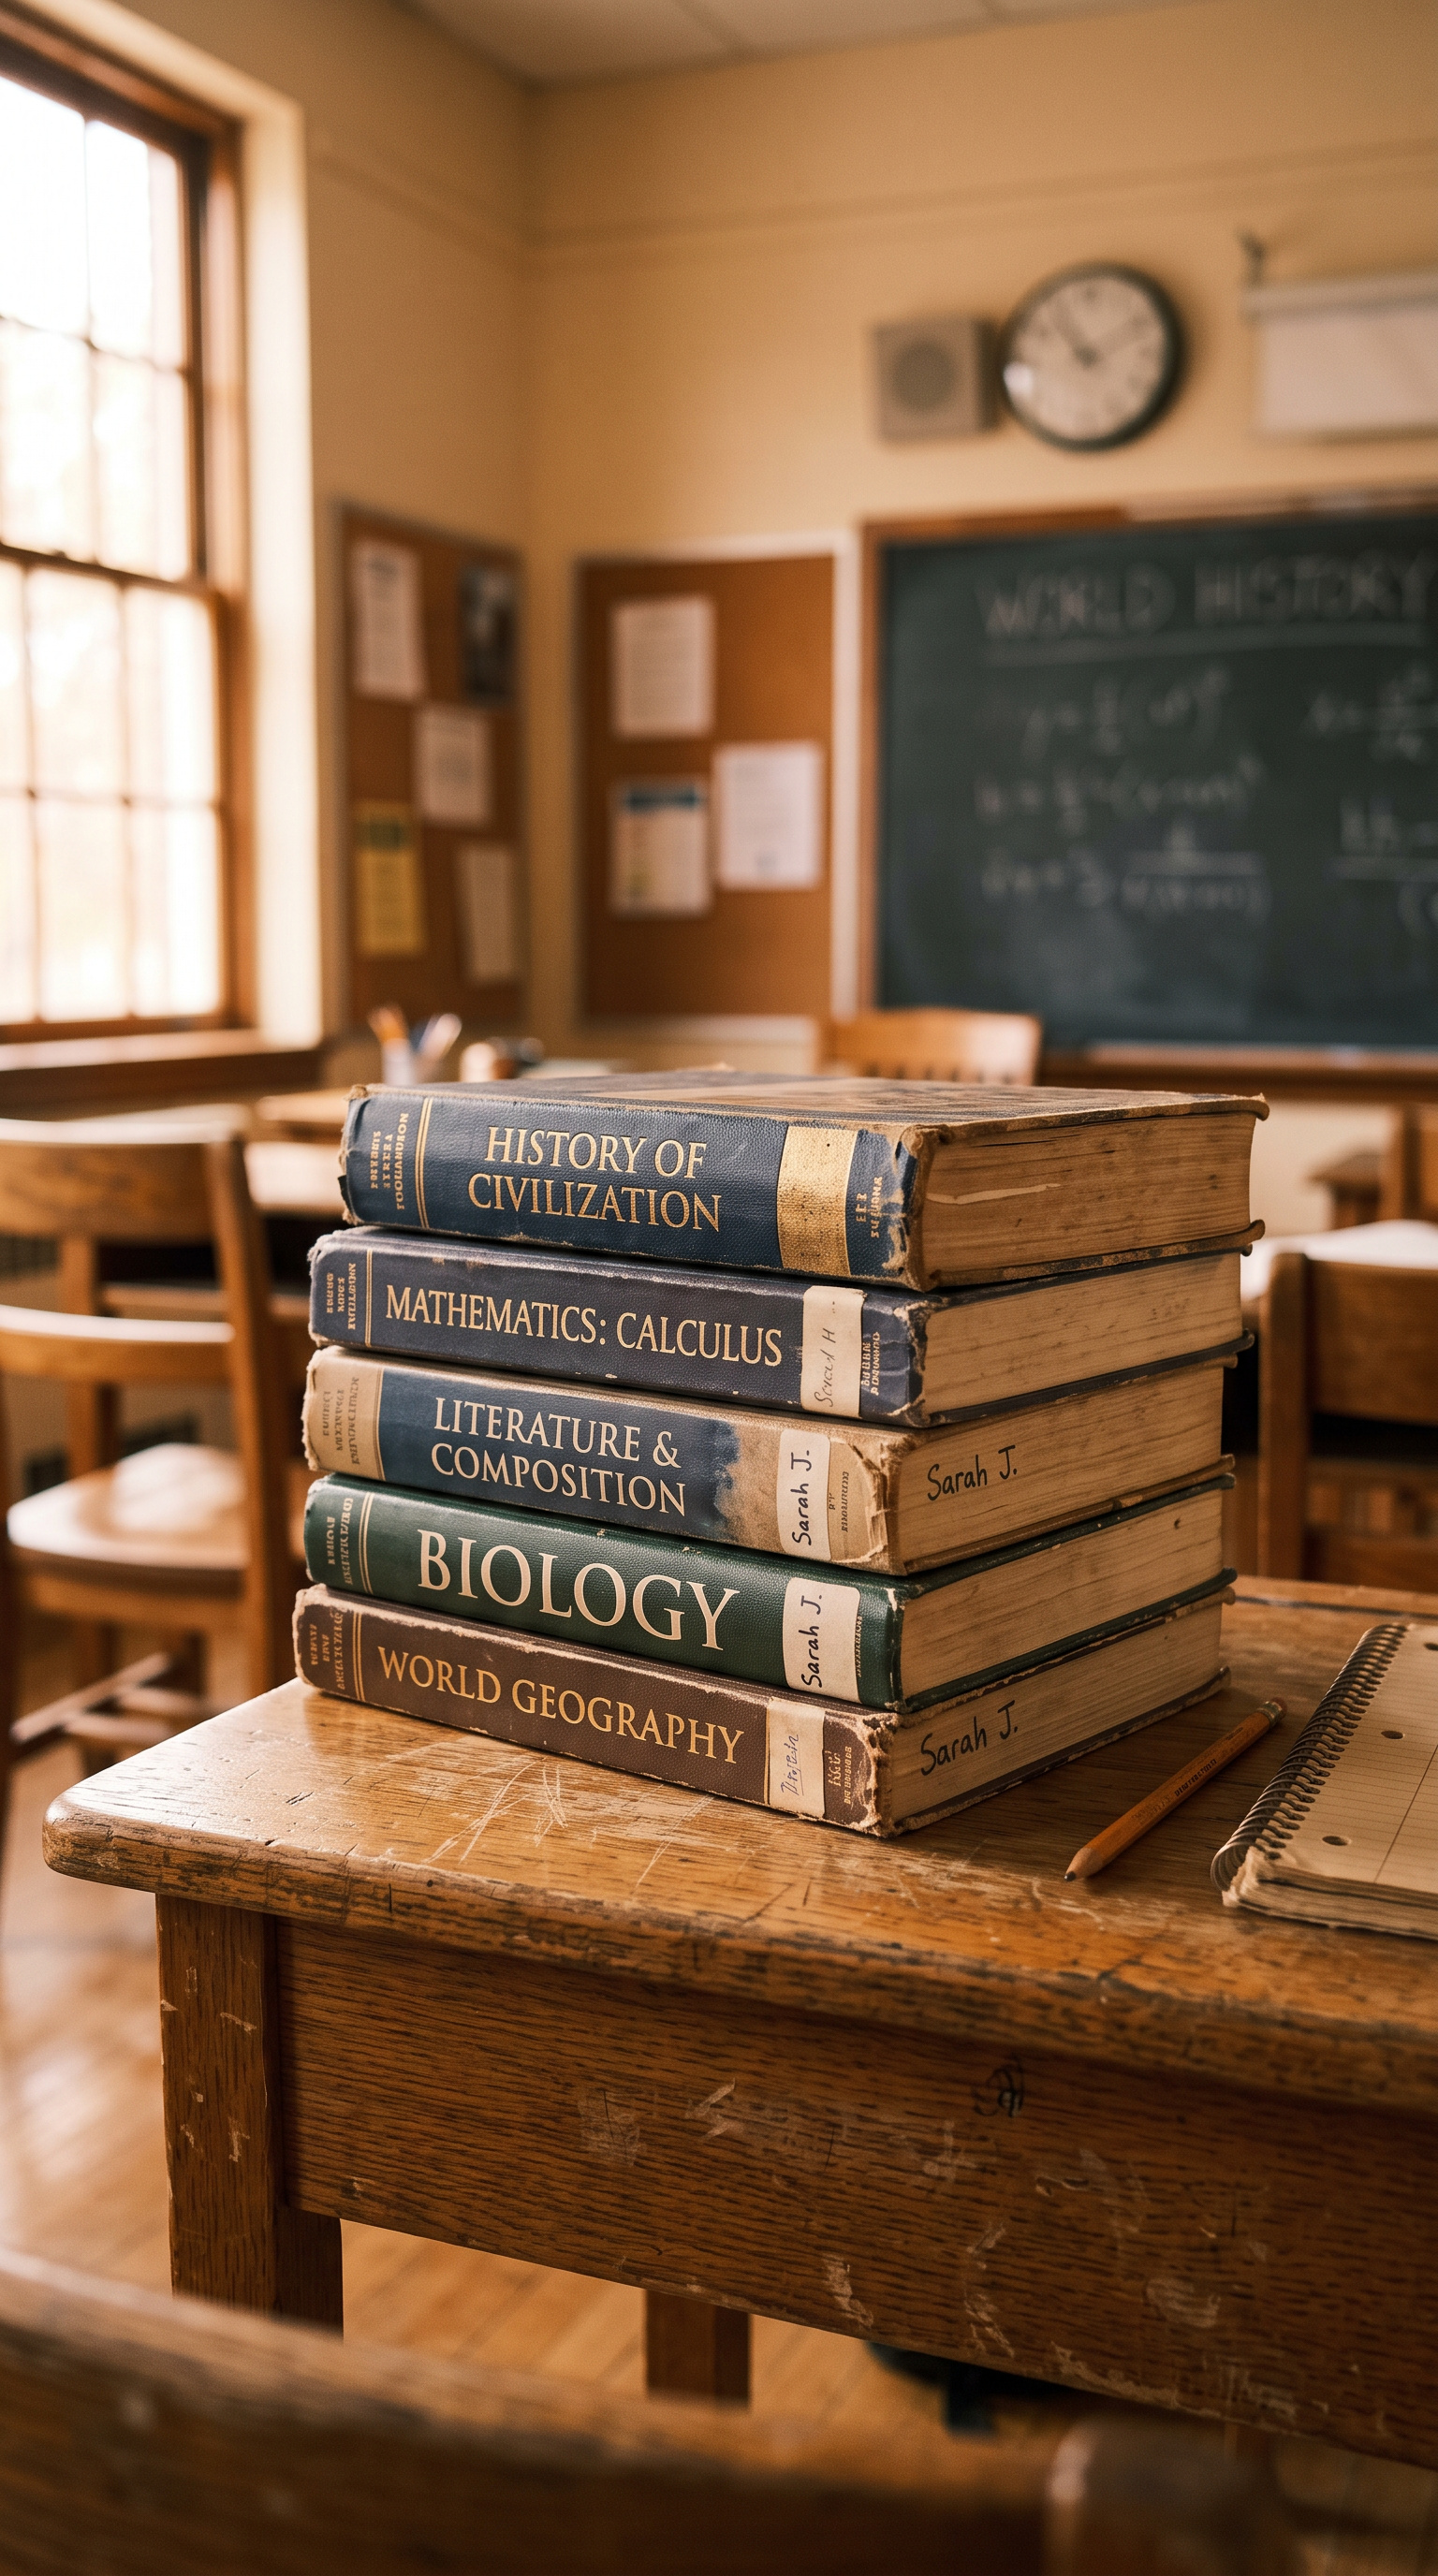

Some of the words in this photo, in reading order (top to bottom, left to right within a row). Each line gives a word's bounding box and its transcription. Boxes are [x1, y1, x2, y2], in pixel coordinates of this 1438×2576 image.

[484, 1126, 647, 1174] HISTORY
[654, 1139, 707, 1178] OF
[468, 1173, 722, 1233] CIVILIZATION
[386, 1284, 606, 1345] MATHEMATICS:
[616, 1312, 782, 1367] CALCULUS
[433, 1397, 640, 1461] LITERATURE
[653, 1430, 682, 1469] &
[790, 1450, 812, 1472] J.
[431, 1442, 686, 1516] COMPOSITION
[927, 1454, 988, 1501] Sarah
[998, 1444, 1018, 1480] J.
[791, 1483, 812, 1545] Sarah
[418, 1529, 741, 1651] BIOLOGY
[800, 1594, 823, 1616] J.
[799, 1626, 823, 1688] Sarah
[377, 1646, 502, 1704] WORLD
[511, 1678, 745, 1764] GEOGRAPHY
[920, 1716, 988, 1777] Sarah
[997, 1699, 1019, 1740] J.
